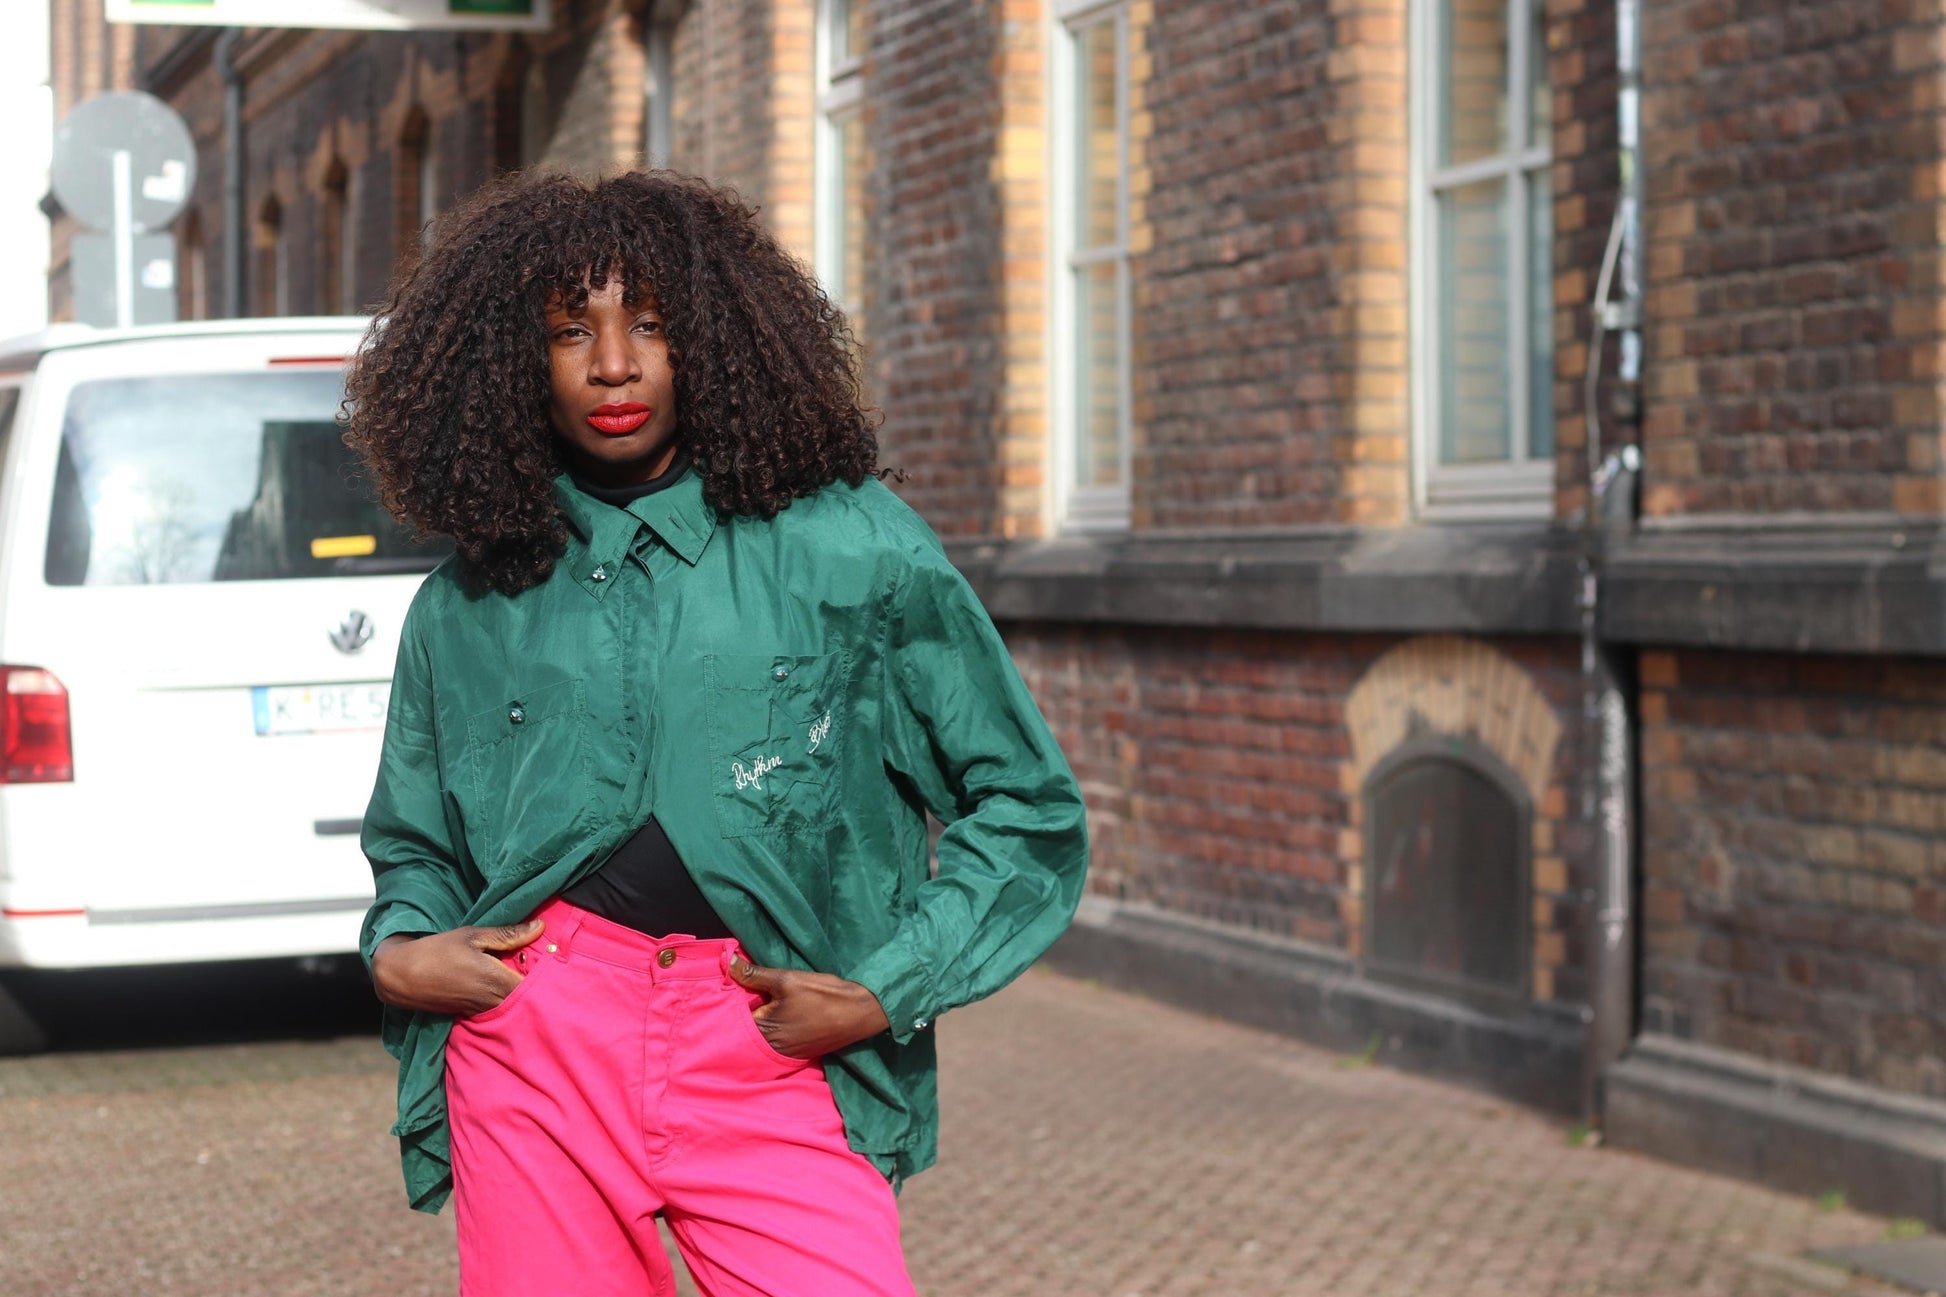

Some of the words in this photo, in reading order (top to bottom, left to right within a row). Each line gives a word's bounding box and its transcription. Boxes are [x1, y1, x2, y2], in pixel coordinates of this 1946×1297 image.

[275, 695, 292, 720] K
[318, 690, 358, 720] RE
[732, 755, 782, 790] Rhythm
